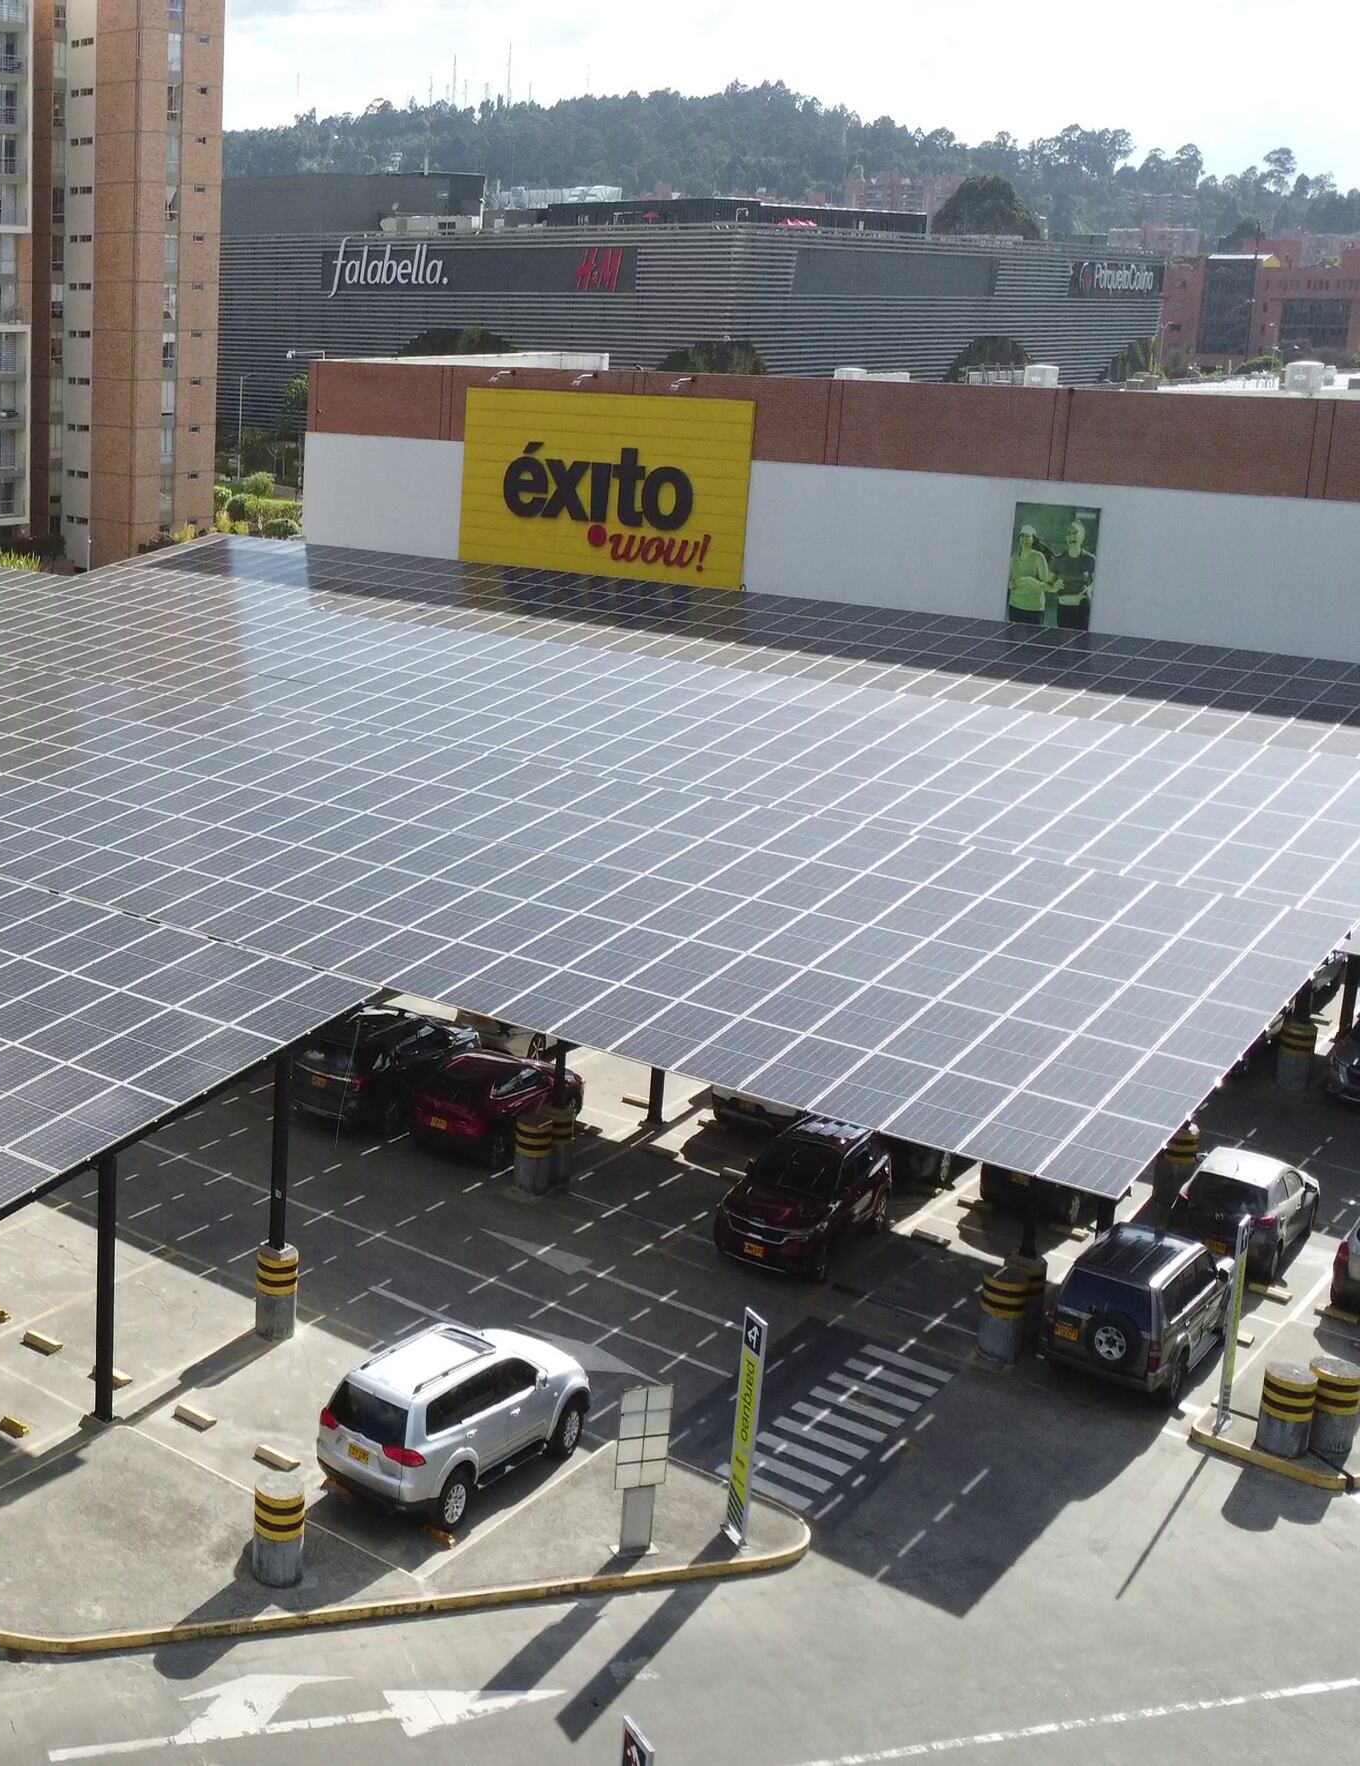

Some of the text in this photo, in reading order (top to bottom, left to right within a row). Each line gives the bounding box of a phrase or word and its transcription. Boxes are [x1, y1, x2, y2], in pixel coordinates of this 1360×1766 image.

[328, 236, 448, 298] falabella.
[575, 247, 622, 292] H&M
[503, 441, 693, 531] éxito
[609, 534, 711, 572] wow!
[741, 1359, 755, 1442] parqueo
